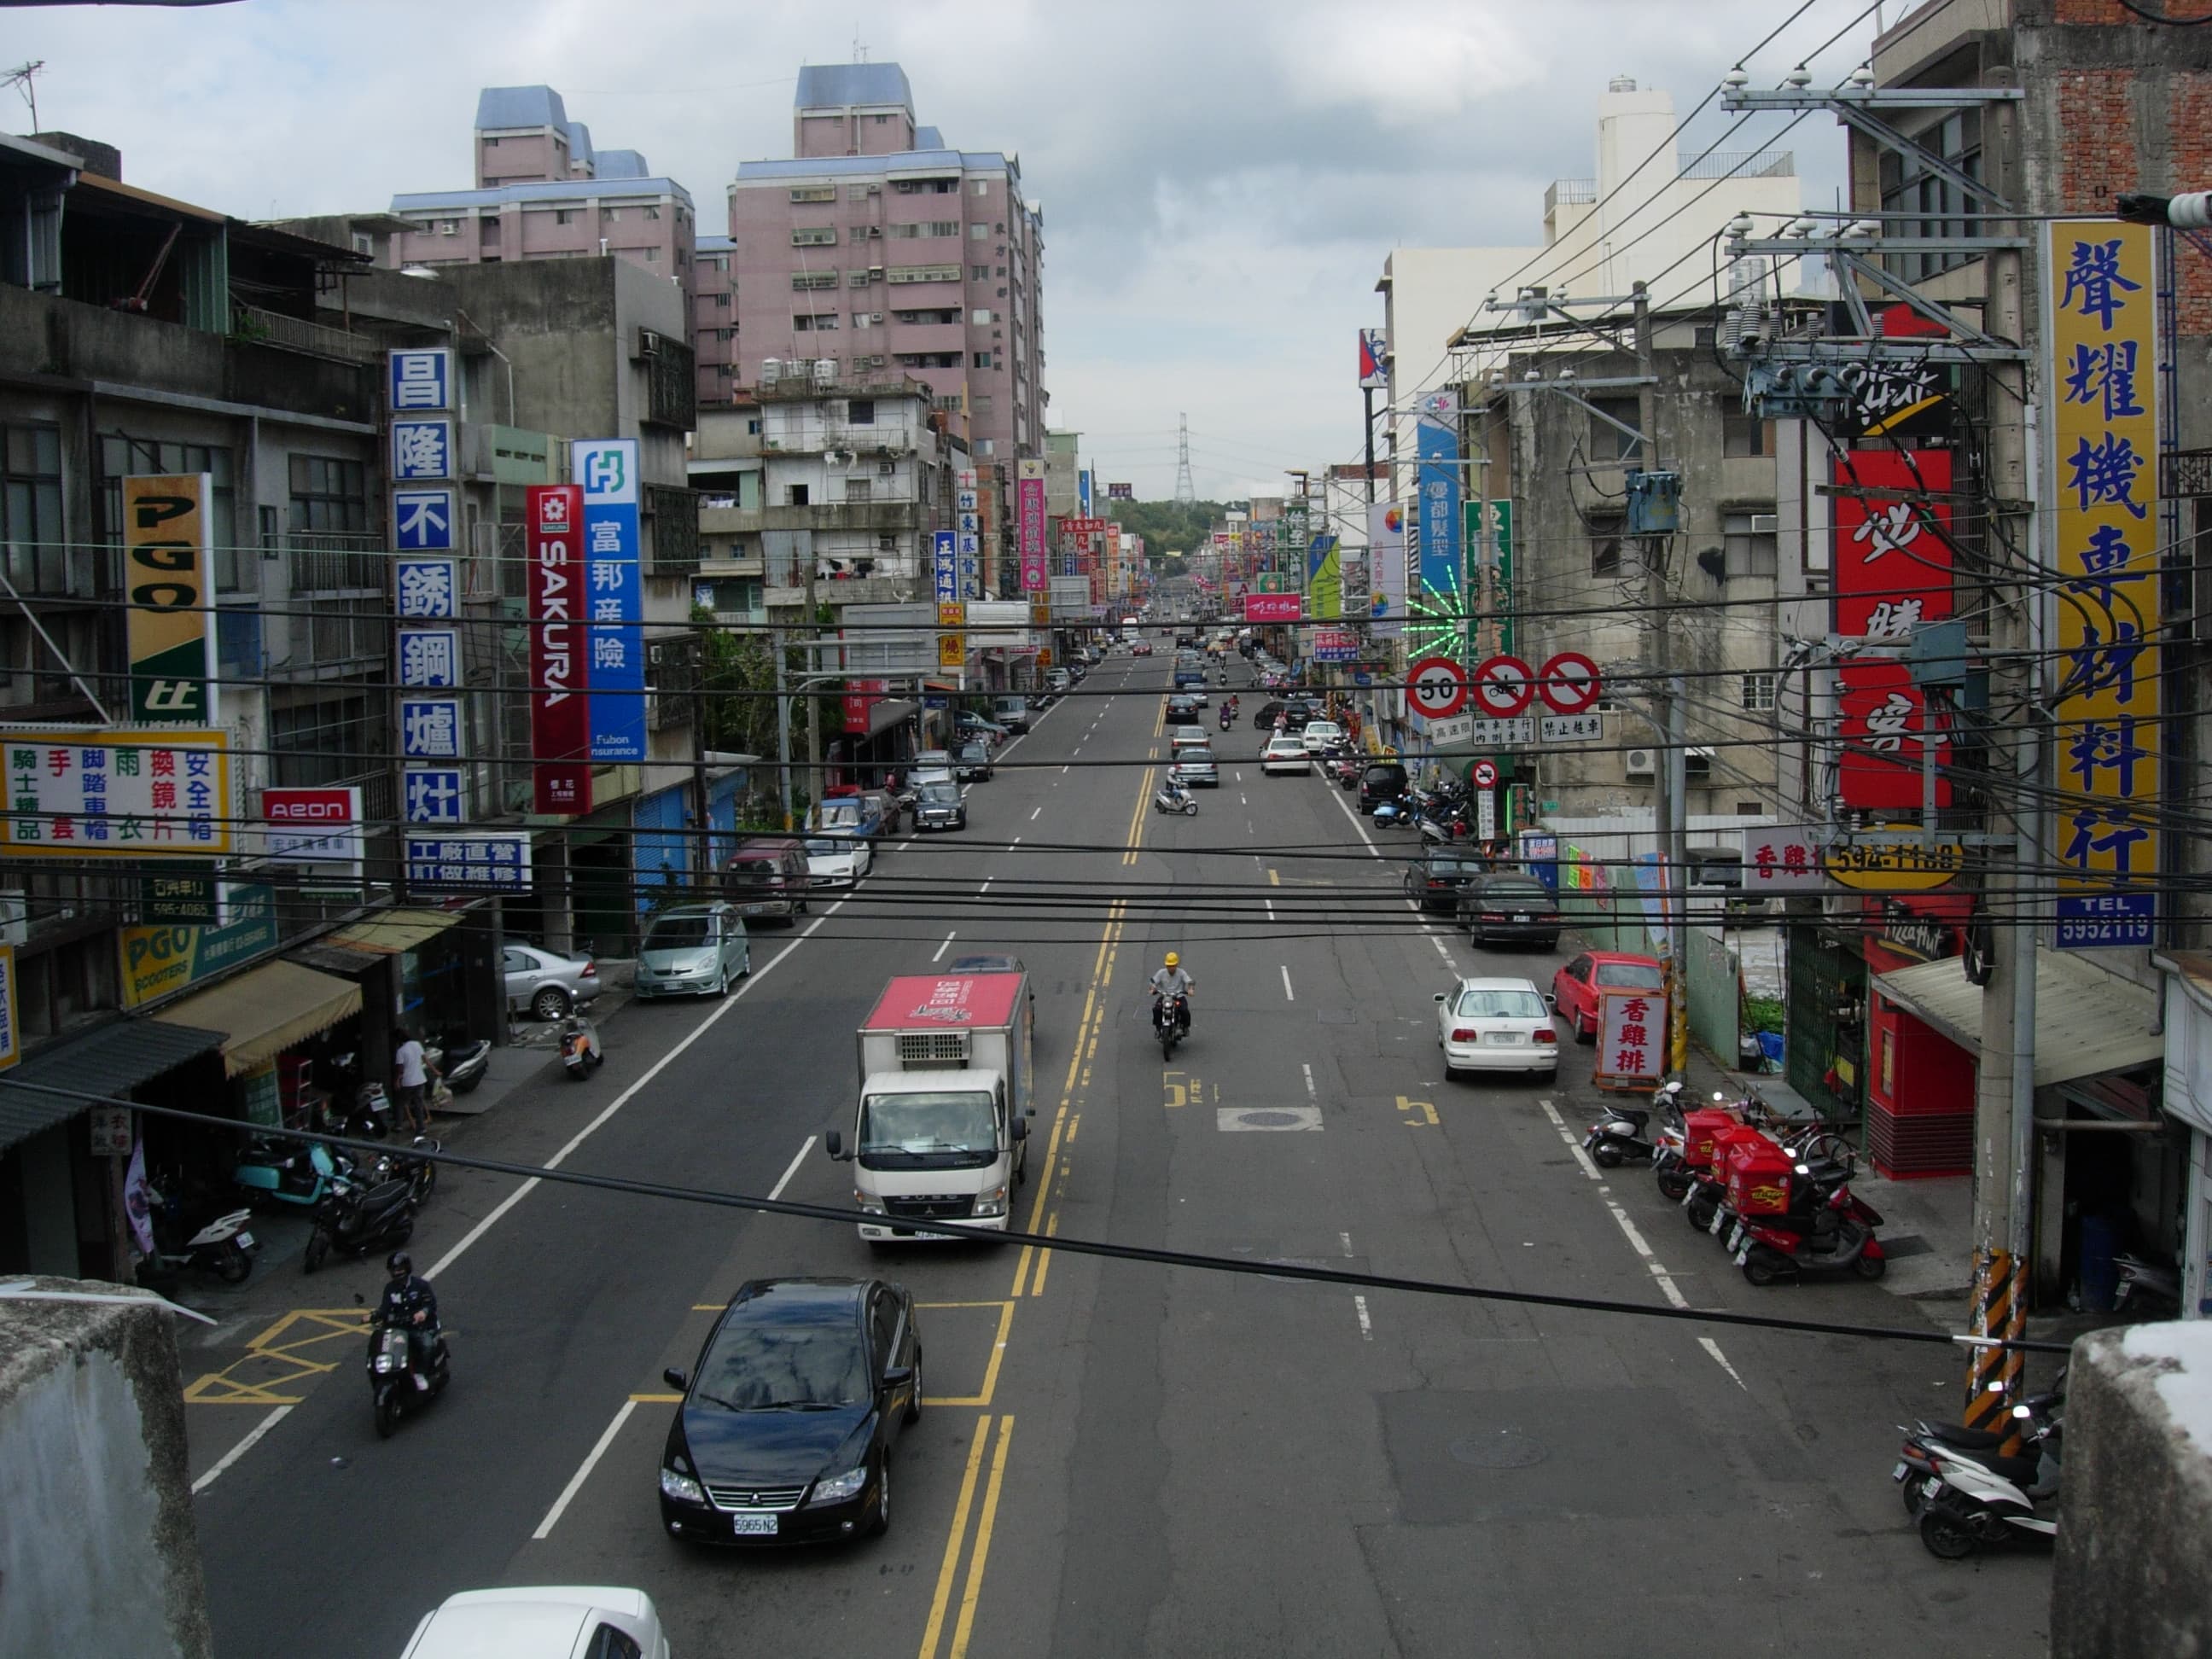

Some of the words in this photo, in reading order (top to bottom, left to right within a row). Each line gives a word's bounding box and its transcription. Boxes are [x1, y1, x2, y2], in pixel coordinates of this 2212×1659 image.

[131, 495, 197, 614] PGO
[540, 540, 570, 707] SAKURA
[591, 520, 626, 669] 富邦產險
[1421, 678, 1452, 701] 50
[591, 748, 638, 757] nsurance
[596, 735, 629, 745] Fubon
[48, 749, 74, 840] 手套
[115, 748, 143, 840] 雨衣
[185, 750, 212, 840] 安全帽
[412, 841, 515, 860] 工廠直營
[2081, 898, 2131, 911] TEL
[130, 926, 191, 971] PGO
[1615, 998, 1650, 1074] 香雞排
